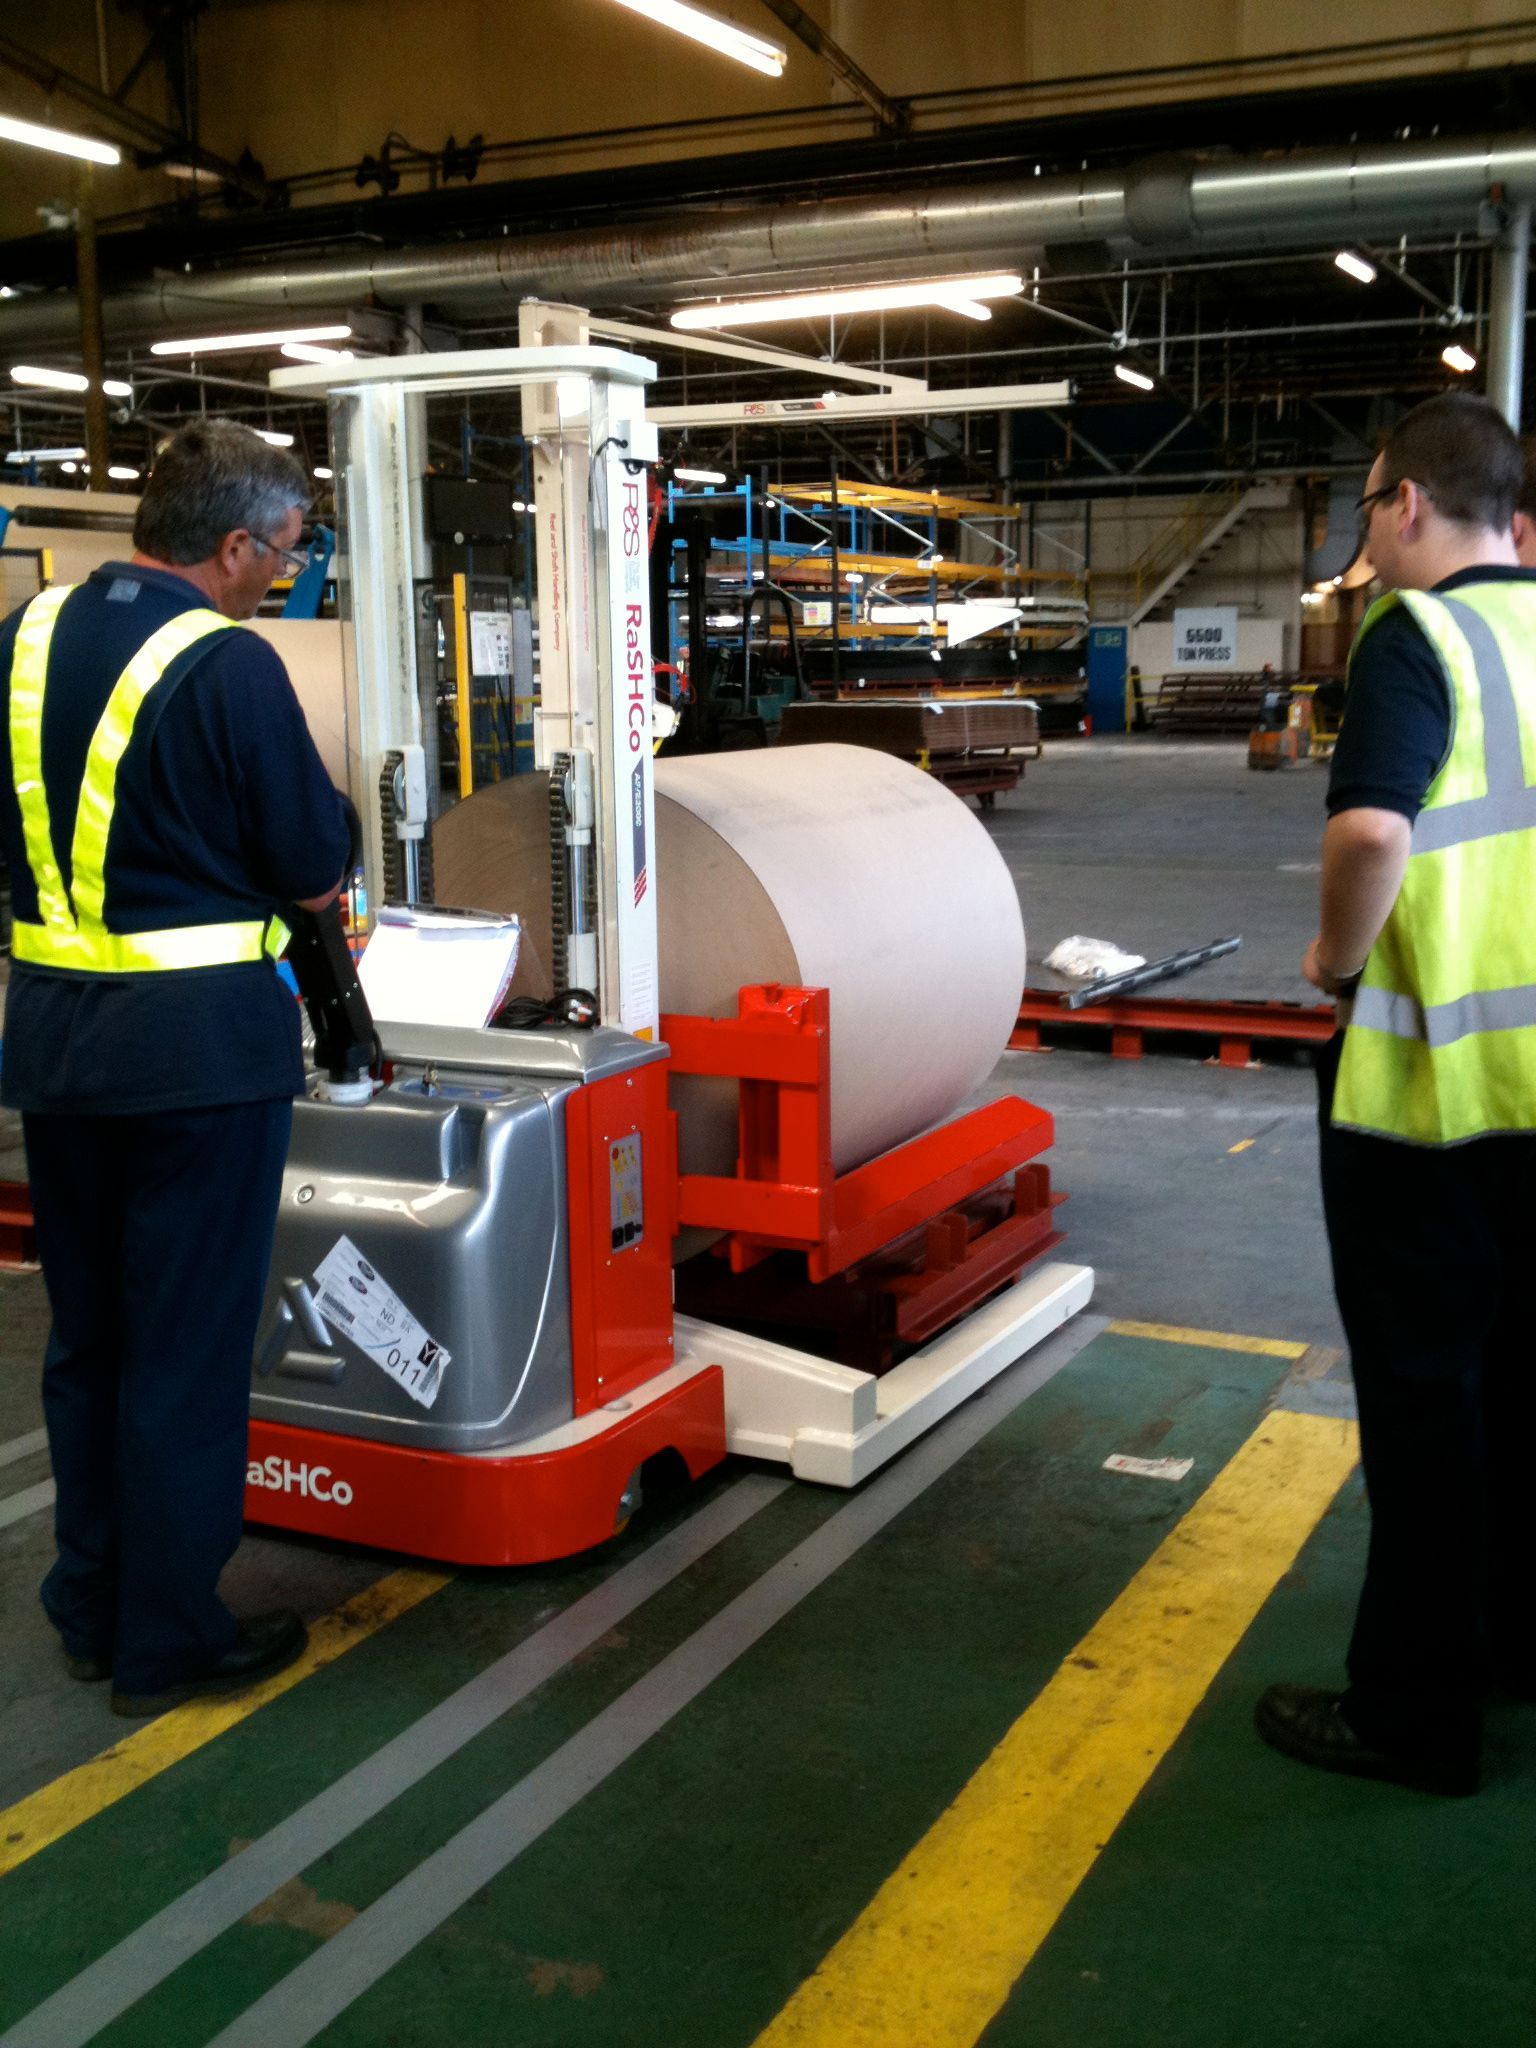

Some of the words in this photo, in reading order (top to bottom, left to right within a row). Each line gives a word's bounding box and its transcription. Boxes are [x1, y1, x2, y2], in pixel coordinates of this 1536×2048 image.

[552, 574, 560, 610] Handling
[1178, 647, 1196, 661] TON
[1198, 646, 1231, 661] PRESS
[626, 604, 645, 752] RaSHCo
[387, 1348, 421, 1386] 011
[246, 1456, 353, 1506] aSHCo
